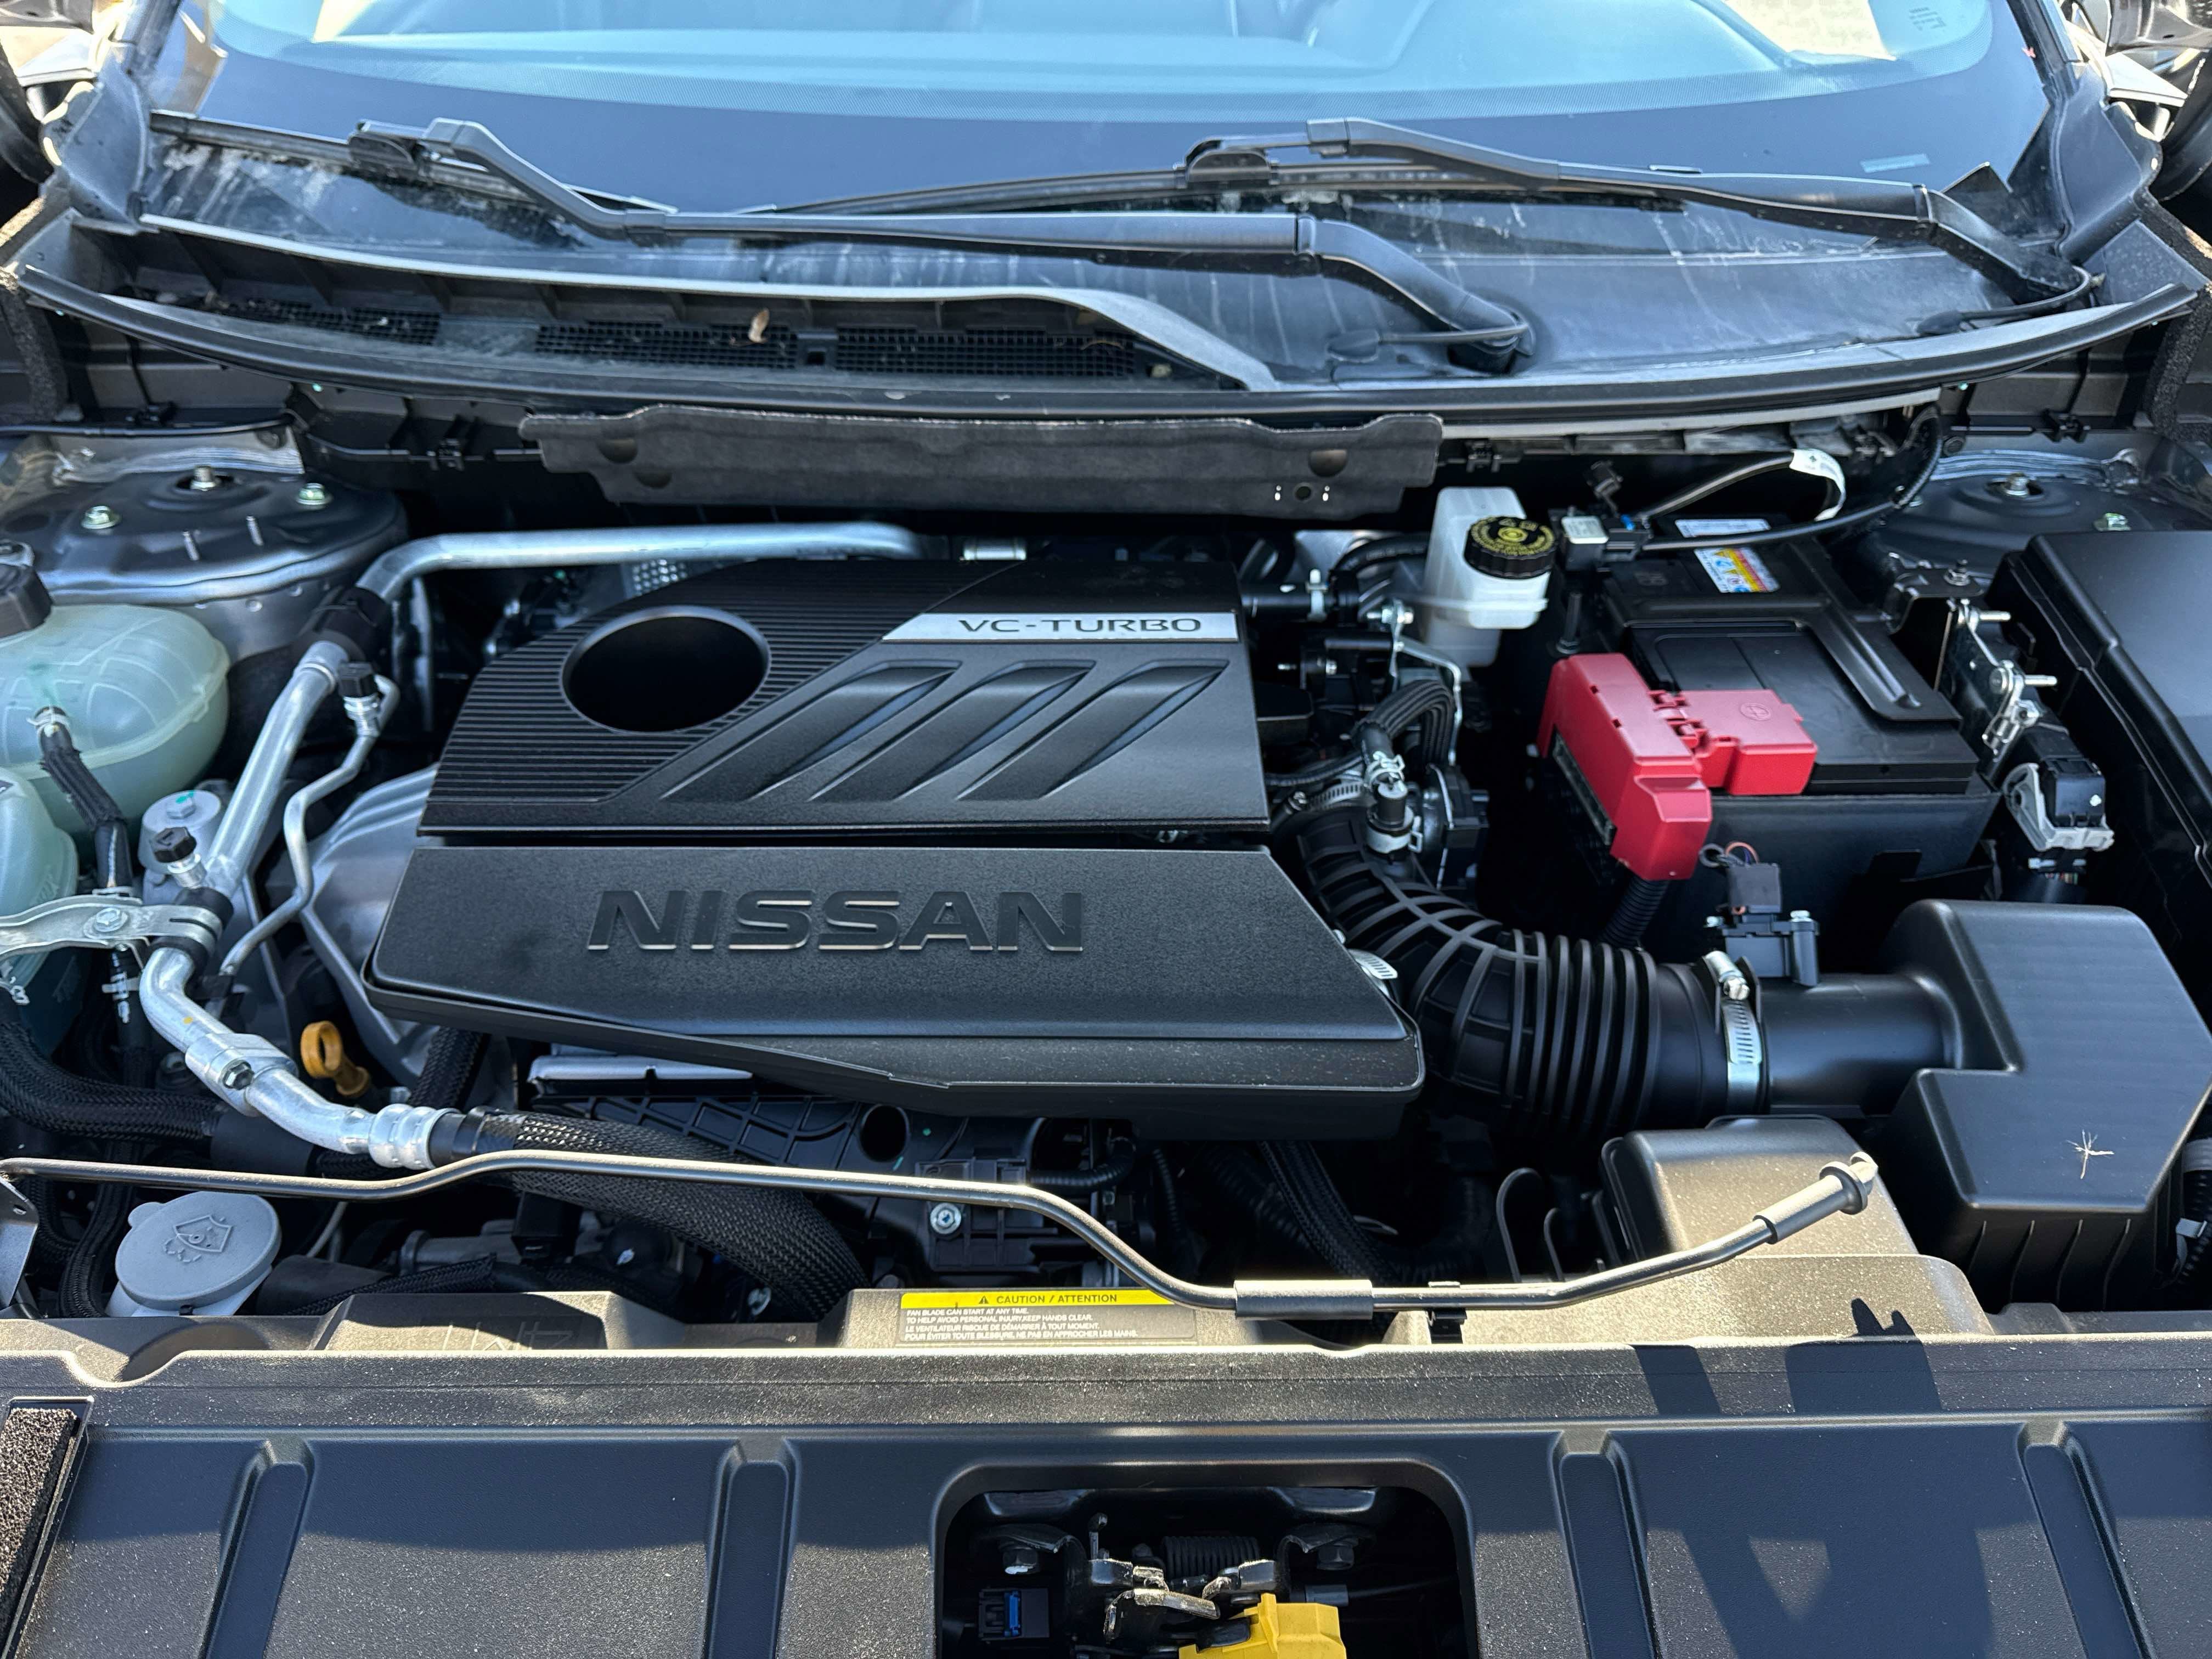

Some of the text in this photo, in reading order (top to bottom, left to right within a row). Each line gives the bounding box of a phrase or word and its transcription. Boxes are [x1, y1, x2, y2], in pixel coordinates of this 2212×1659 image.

[957, 618, 1201, 633] VC-TURBO
[586, 890, 1084, 951] NISSAN
[996, 1295, 1045, 1304] CAUTION
[1057, 1294, 1117, 1303] ATTENTION
[960, 1315, 998, 1323] PERSONAL
[1001, 1322, 1041, 1331] DÉMARRER
[904, 1333, 926, 1341] POUR
[927, 1331, 951, 1340] ÉVITER
[1015, 1331, 1026, 1339] NE
[1053, 1330, 1098, 1339] APPROCHER
